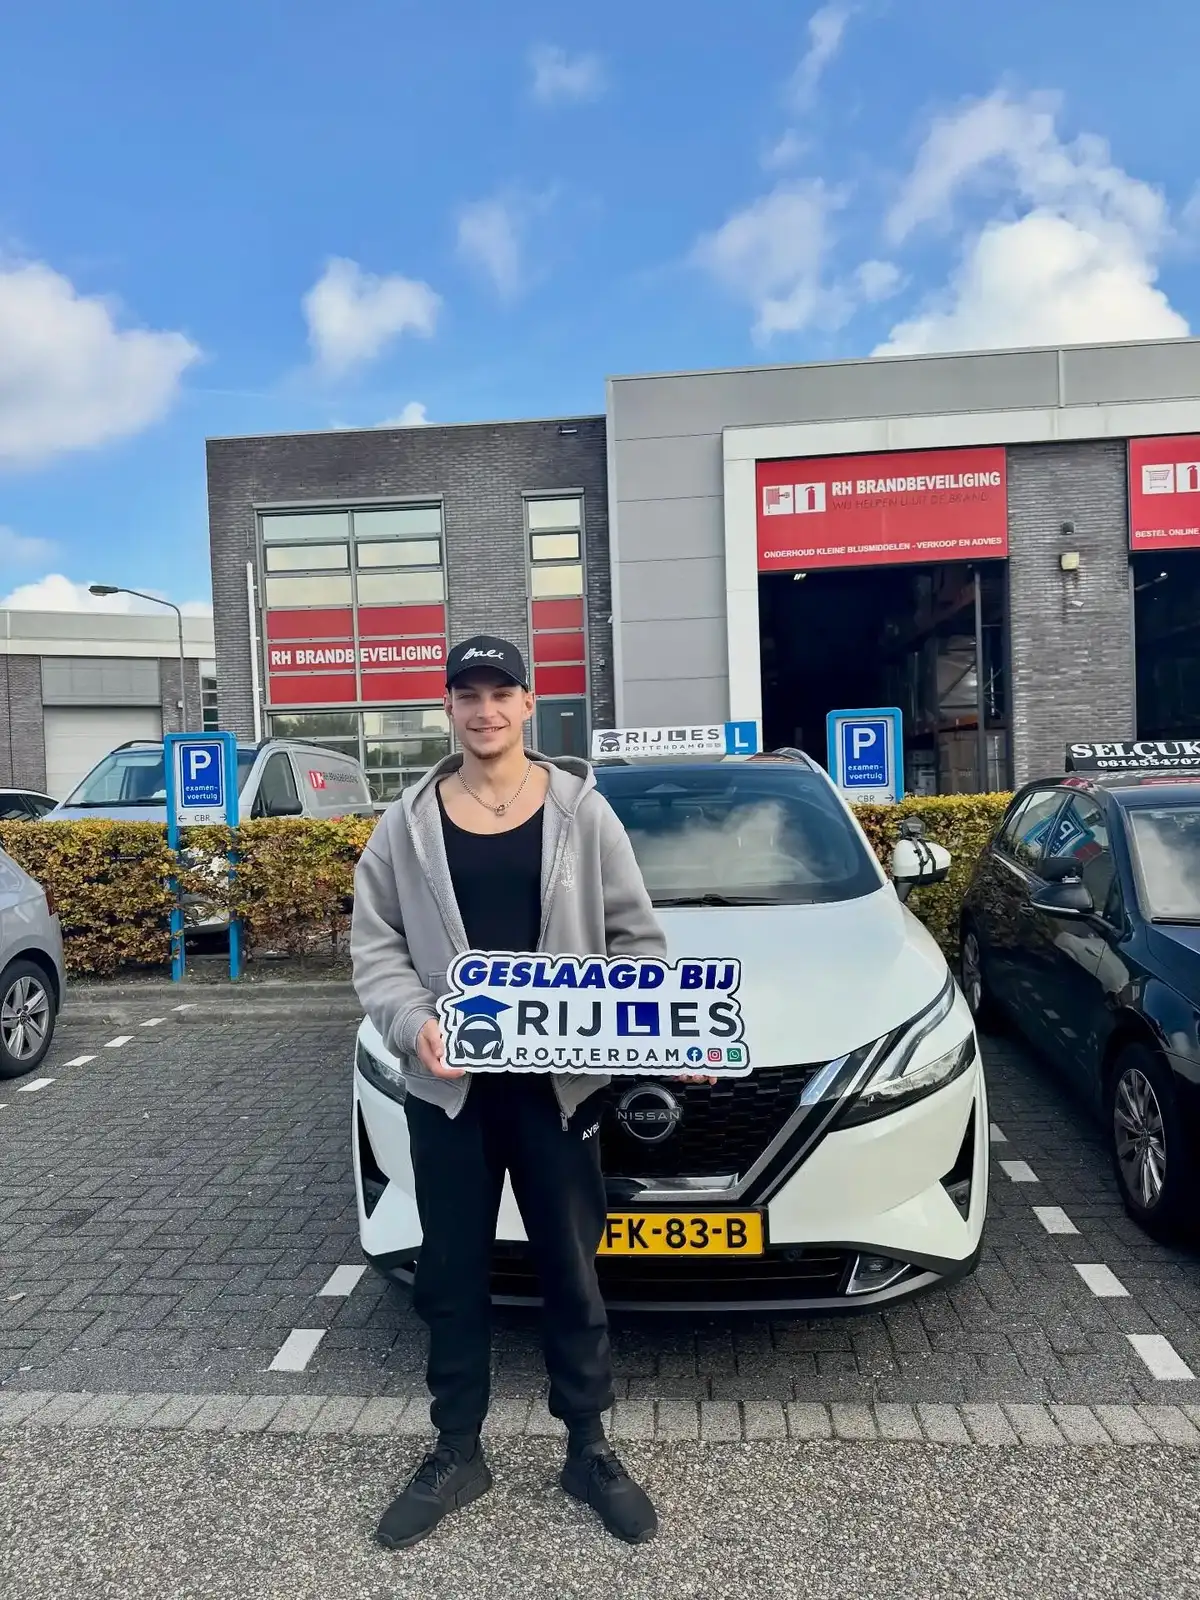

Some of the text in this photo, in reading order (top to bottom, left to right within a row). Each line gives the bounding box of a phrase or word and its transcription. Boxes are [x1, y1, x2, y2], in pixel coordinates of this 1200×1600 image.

[832, 471, 1001, 496] RH BRANDBEVEILIGING
[1135, 527, 1200, 538] BESTEL ONLINE
[764, 548, 815, 559] ONDERHOUD
[816, 546, 846, 556] KLEINE
[847, 543, 911, 554] BLUSMIDDELEN
[916, 540, 958, 549] VERKOOP
[959, 538, 971, 547] EN
[972, 537, 1003, 546] ADVIES
[271, 645, 443, 665] RH BRANDBEVEILIGING
[625, 728, 720, 744] RIJLES
[734, 727, 749, 748] L
[853, 727, 877, 760] P
[625, 743, 695, 752] ROTTERDAM
[1070, 741, 1200, 760] SELÇUK
[190, 749, 212, 780] P
[849, 772, 883, 781] voertuig
[185, 784, 219, 792] examen-
[186, 792, 218, 801] voertuig
[857, 794, 875, 803] CBR
[194, 814, 211, 822] CBR
[459, 960, 735, 990] GESLAAGD BIJ
[516, 1000, 738, 1038] RIJLES
[515, 1046, 680, 1062] ROTTERDAM
[617, 1110, 681, 1121] NISSAN
[606, 1217, 748, 1249] FK-83-B
